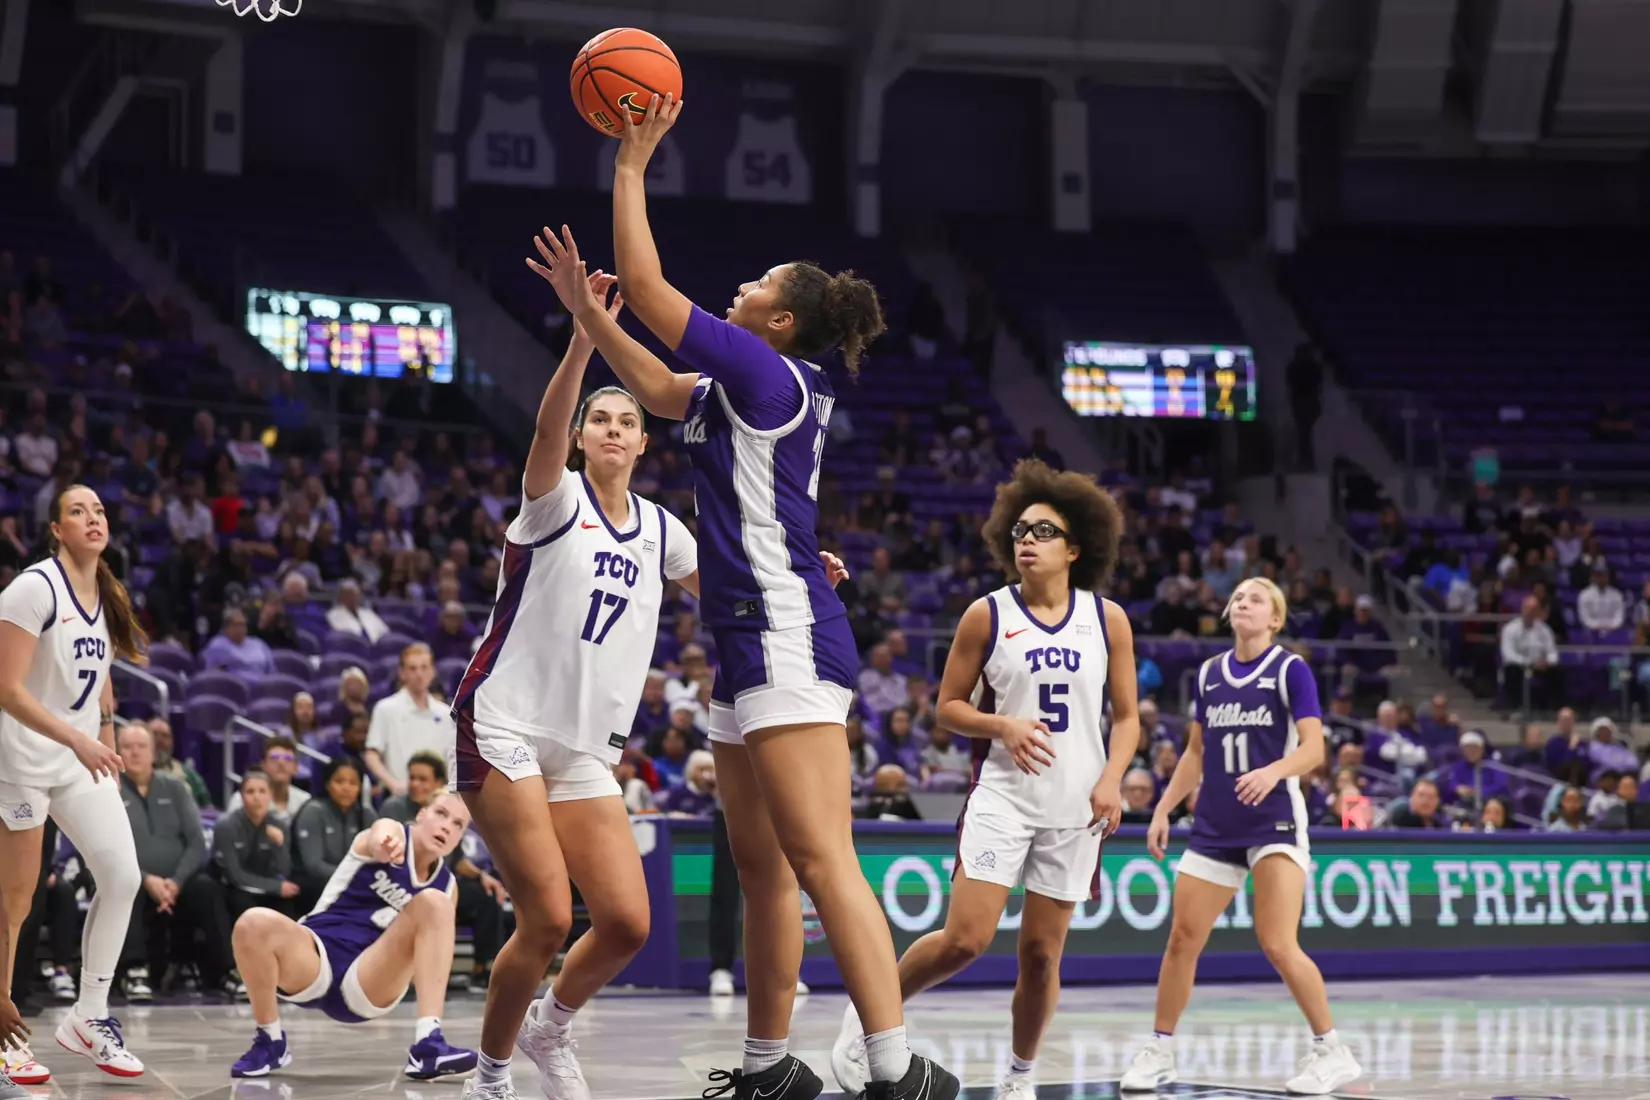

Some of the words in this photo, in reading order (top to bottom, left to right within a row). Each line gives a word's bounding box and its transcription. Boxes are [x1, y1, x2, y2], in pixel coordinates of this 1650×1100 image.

[485, 133, 536, 170] 50
[742, 150, 793, 190] 54
[593, 551, 640, 588] TCU
[580, 588, 629, 645] 17
[73, 636, 106, 660] TCU
[1025, 647, 1082, 674] TCU
[69, 669, 97, 711] 7
[1038, 683, 1069, 732] 5
[1205, 702, 1274, 728] Wildcats
[1221, 732, 1249, 774] 11
[1432, 859, 1650, 926] FREIGH
